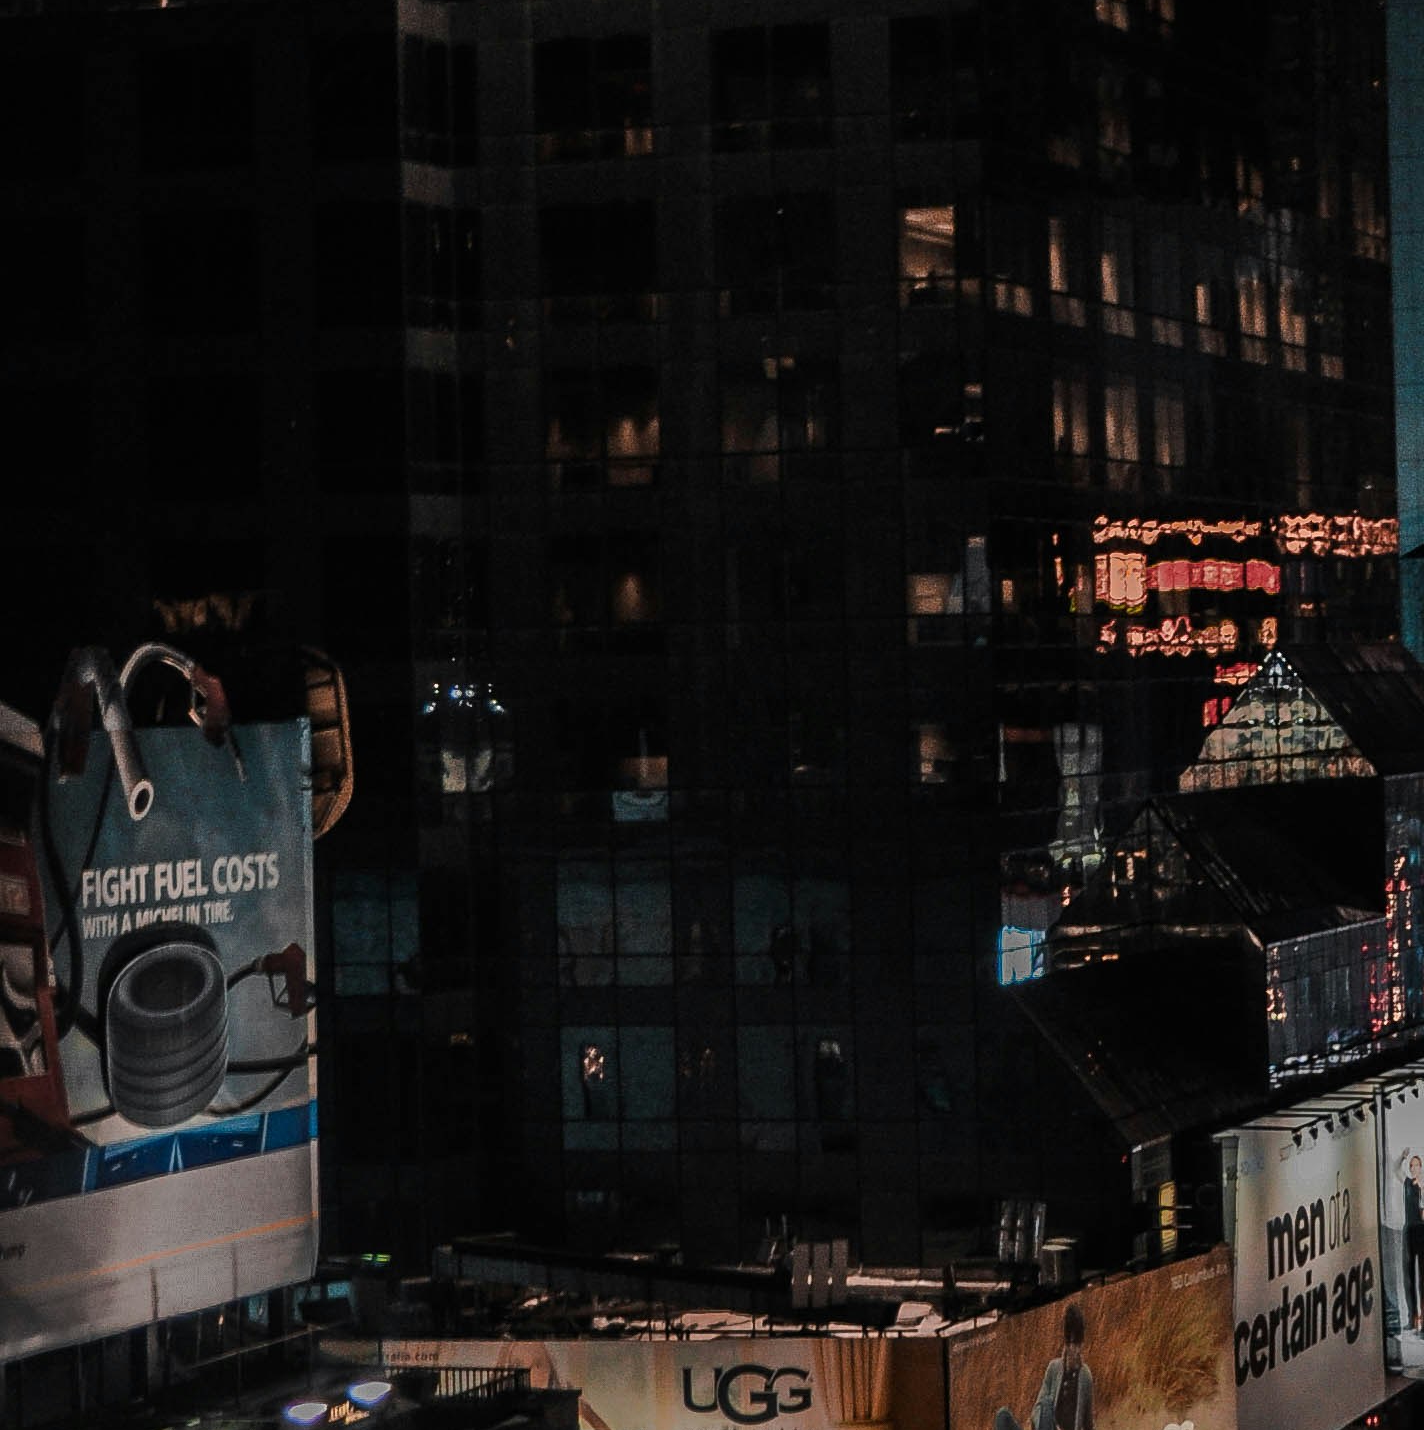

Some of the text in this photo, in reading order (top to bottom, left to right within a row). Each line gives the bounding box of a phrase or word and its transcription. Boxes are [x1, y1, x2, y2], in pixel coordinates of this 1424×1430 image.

[81, 852, 281, 909] FIGHT FUEL COSTS
[81, 913, 118, 940] WITH
[121, 910, 132, 935] A
[1266, 1171, 1350, 1282] men of a
[1234, 1256, 1374, 1388] certain age
[683, 1364, 813, 1426] UGG
